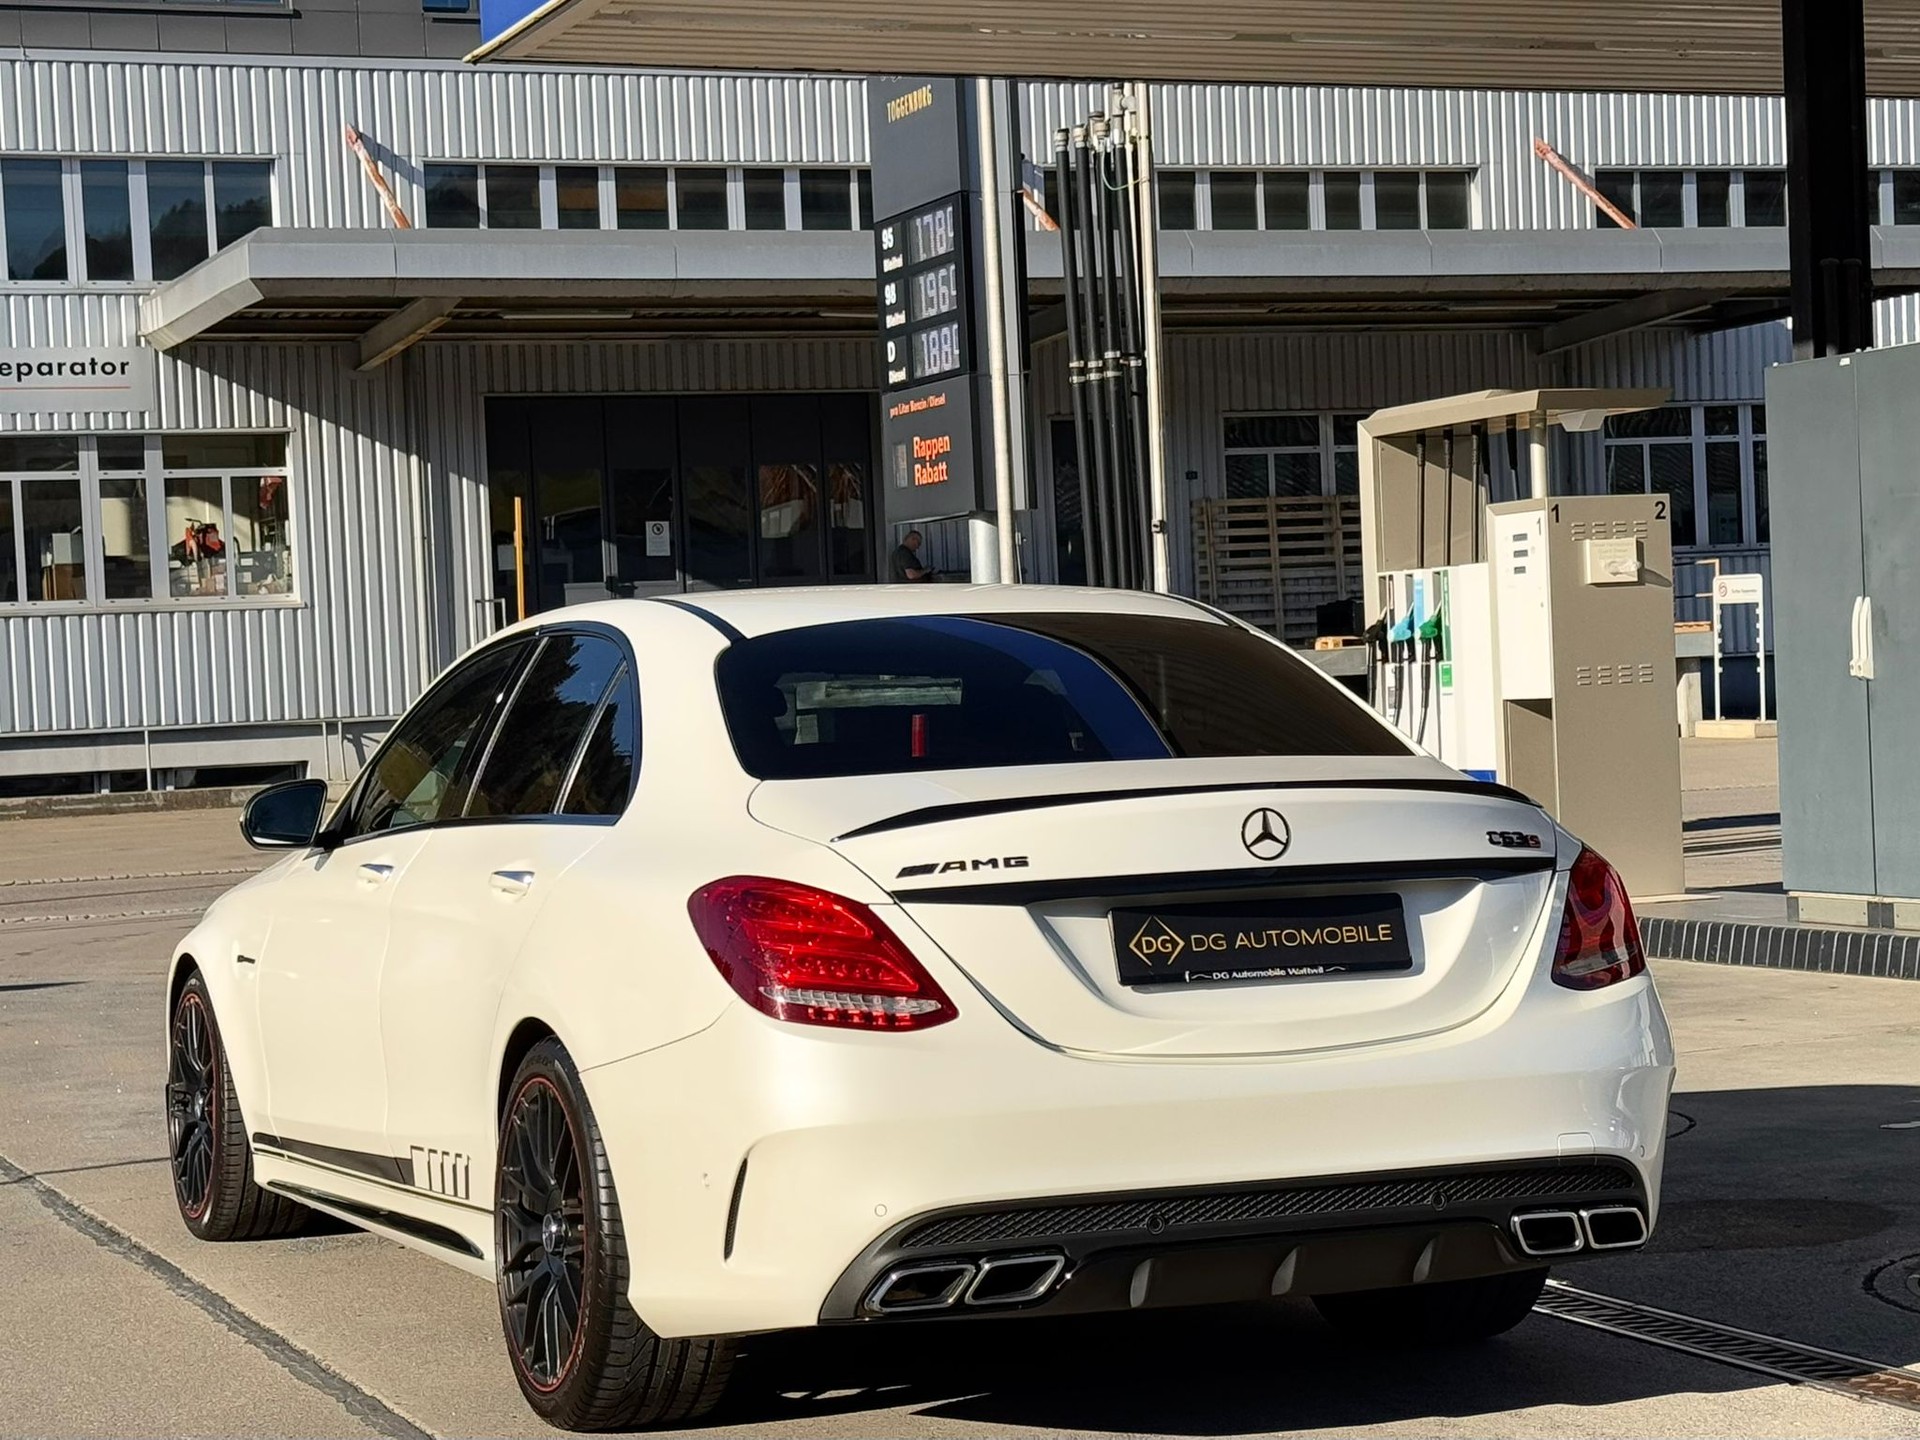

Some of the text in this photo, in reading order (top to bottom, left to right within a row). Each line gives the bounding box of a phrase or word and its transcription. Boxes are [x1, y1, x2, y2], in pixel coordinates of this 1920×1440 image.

[882, 227, 894, 250] 95
[887, 340, 896, 363] D
[0, 357, 130, 382] eparator
[913, 435, 950, 464] Rappen
[914, 461, 948, 487] Rabatt
[1551, 503, 1560, 523] 1
[1654, 500, 1667, 520] 2
[938, 856, 1030, 874] AMG
[1141, 935, 1173, 954] DG
[1191, 924, 1394, 951] DG AUTOMOBILE
[1212, 970, 1229, 980] DG
